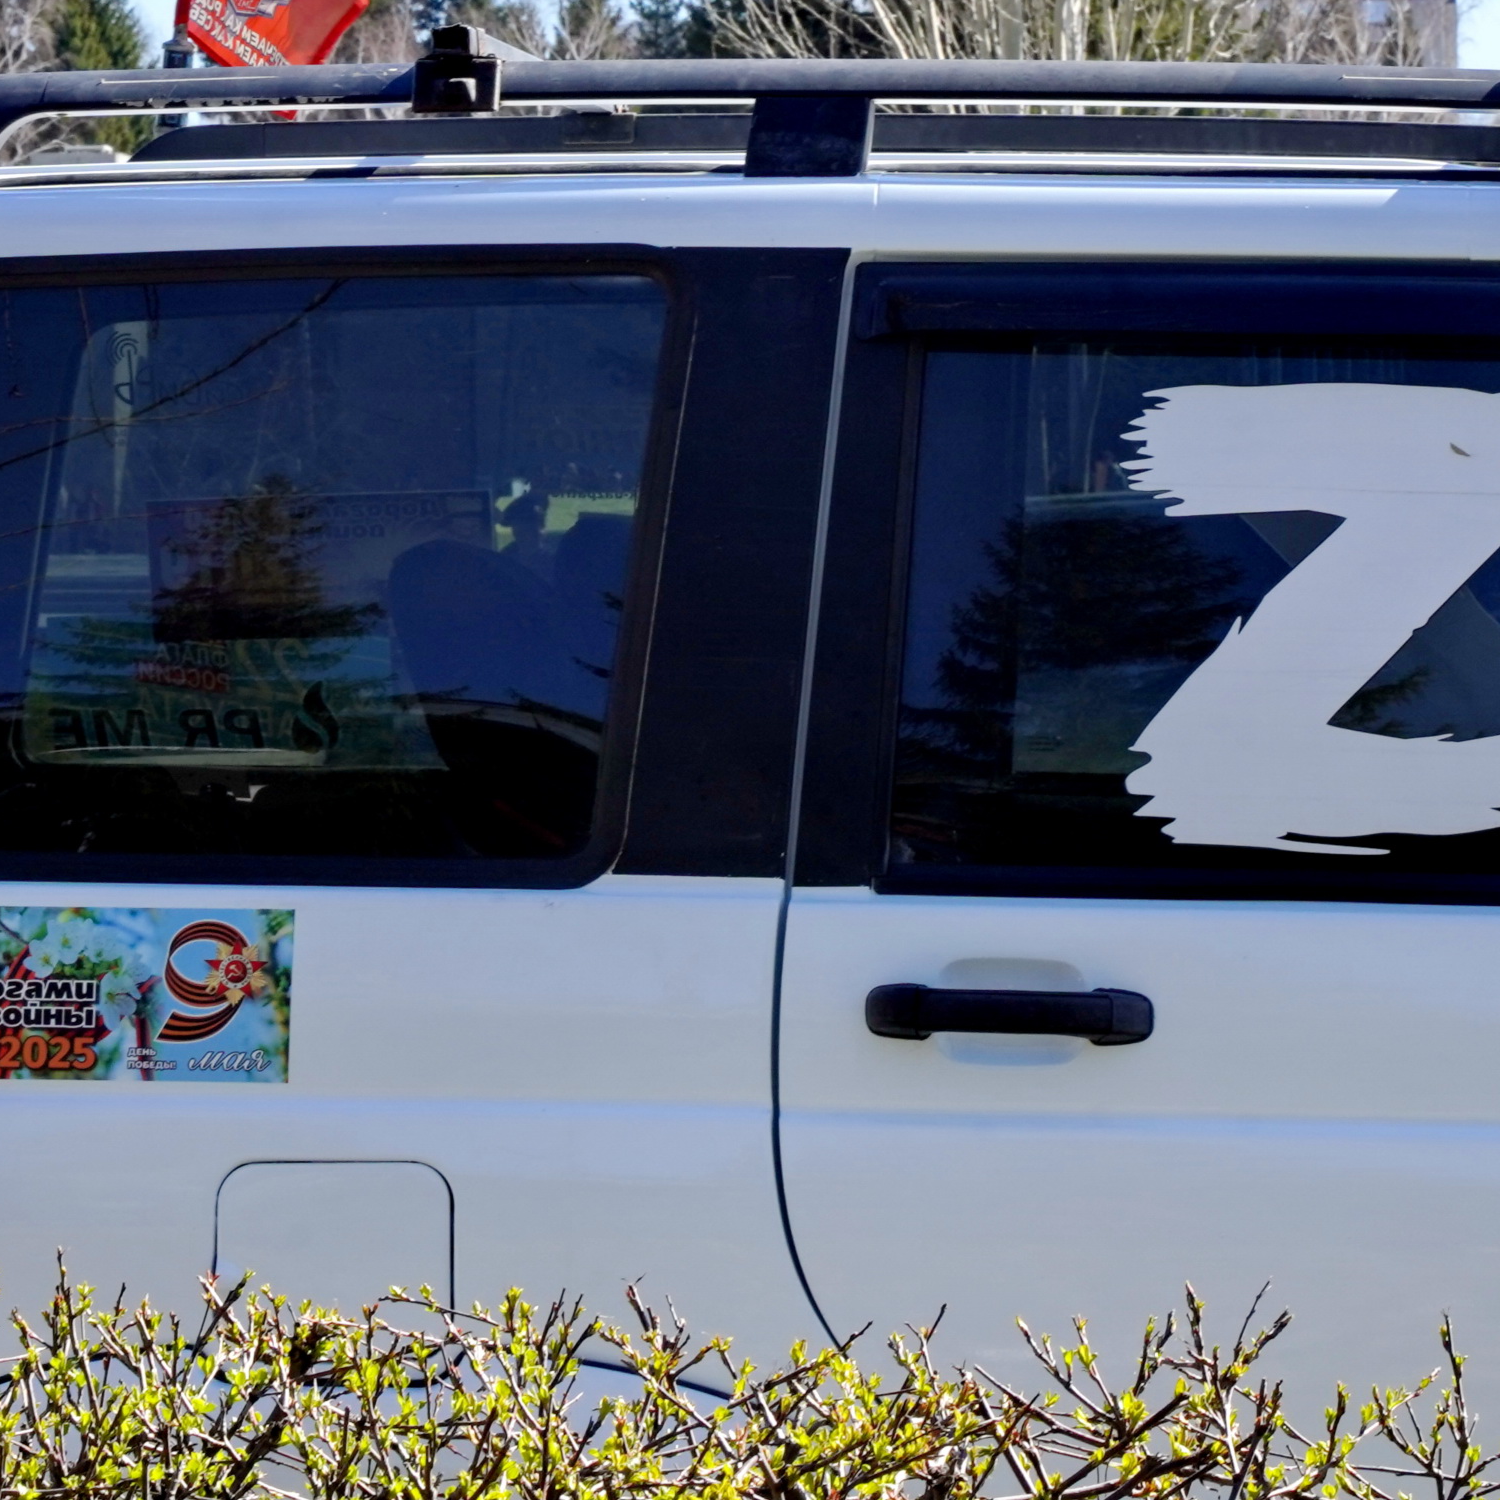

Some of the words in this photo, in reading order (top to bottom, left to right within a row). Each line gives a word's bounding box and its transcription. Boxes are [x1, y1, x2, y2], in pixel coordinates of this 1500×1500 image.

[0, 1035, 97, 1070] 2025
[127, 1046, 157, 1057] ДЕНЬ
[188, 1048, 272, 1071] мая
[126, 1060, 177, 1071] ПОБЕДЫ!
